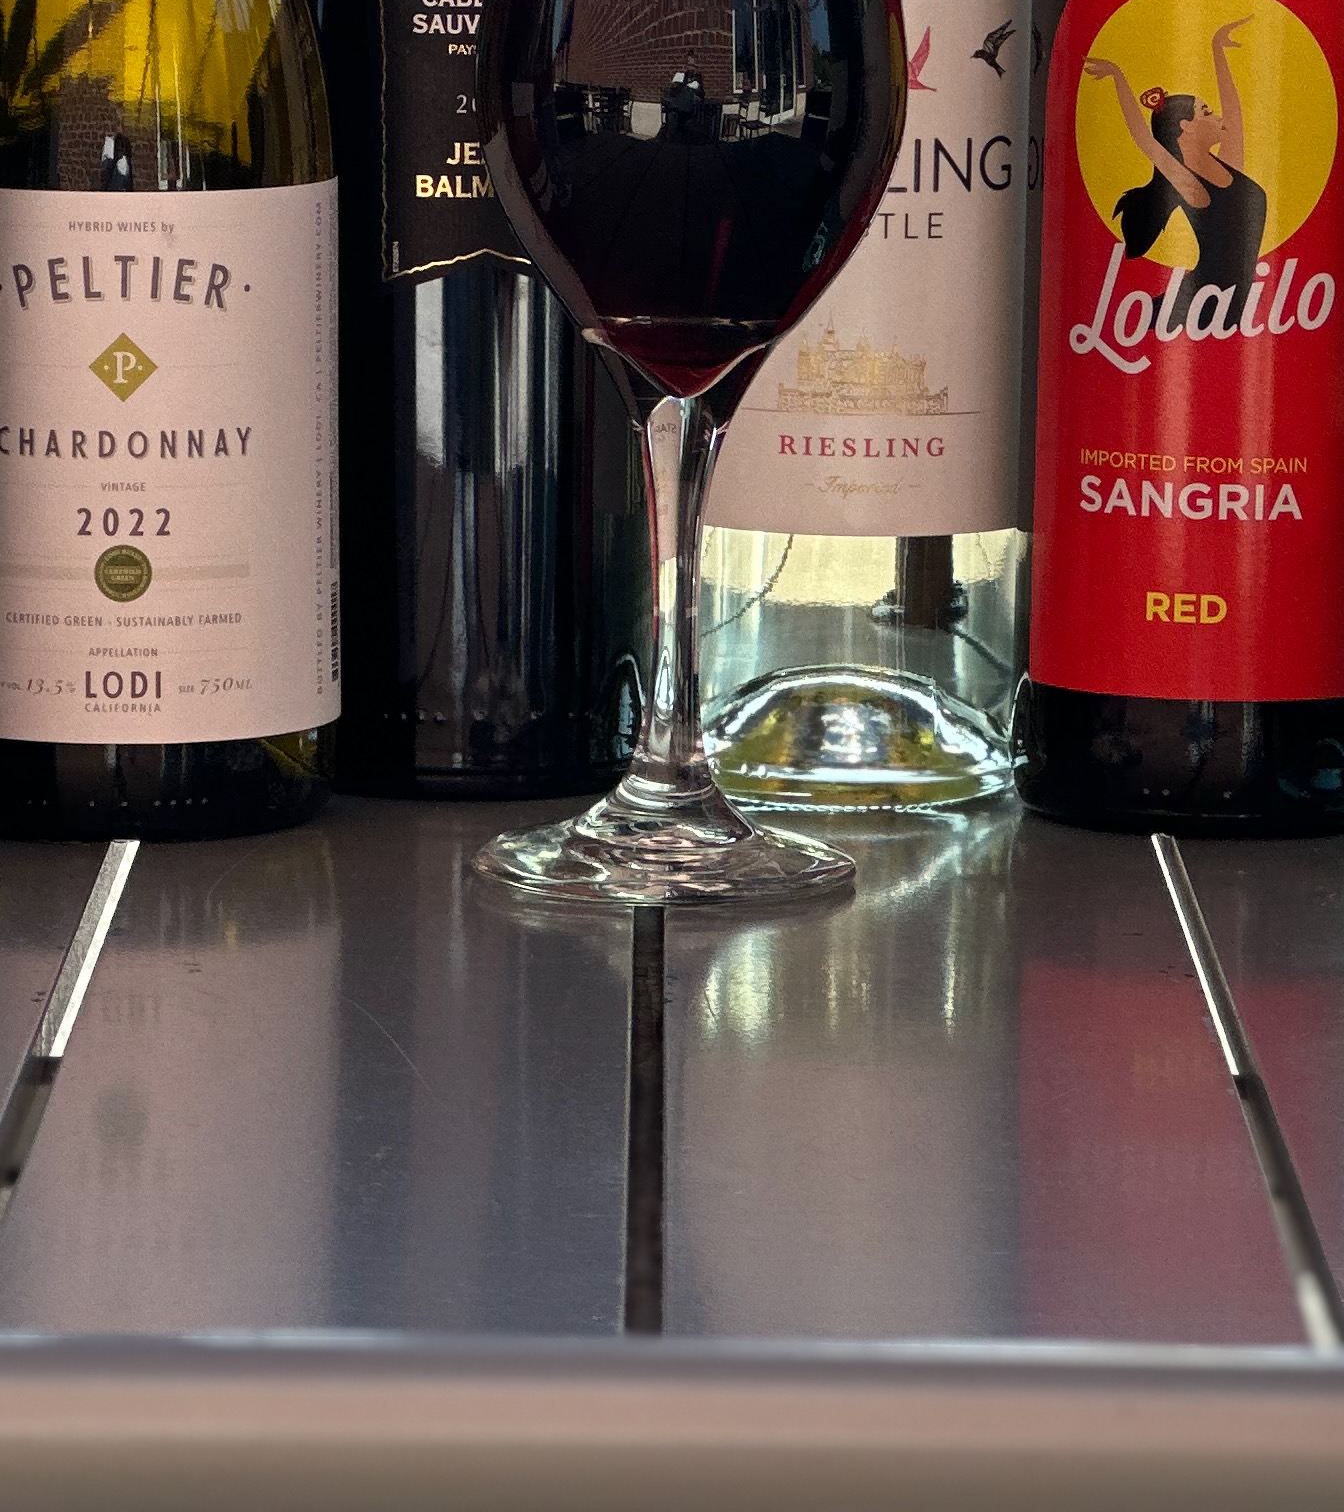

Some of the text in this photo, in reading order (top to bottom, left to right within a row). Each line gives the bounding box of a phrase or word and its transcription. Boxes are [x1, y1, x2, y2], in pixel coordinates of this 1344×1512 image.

[412, 13, 481, 34] SAUV
[446, 141, 485, 165] JE
[415, 174, 496, 199] BALM
[68, 220, 175, 235] HYBRID WINES by
[878, 211, 945, 240] TLE
[11, 254, 233, 312] PELTIER
[1068, 242, 1336, 375] Lolailo
[113, 352, 137, 385] P
[778, 432, 947, 459] RIESLING
[1079, 448, 1308, 474] IMPORTED FROM SPAIN
[100, 482, 147, 493] VINTAGE
[1079, 474, 1303, 521] SANGRIA
[76, 508, 173, 536] 2022
[6, 612, 243, 628] CERTIFIED GREEN SUSTAINABLY FARMED
[1145, 591, 1228, 625] RED
[88, 647, 159, 658] APPELLATION
[84, 670, 162, 700] LODI
[84, 702, 162, 715] CALIFORNIA
